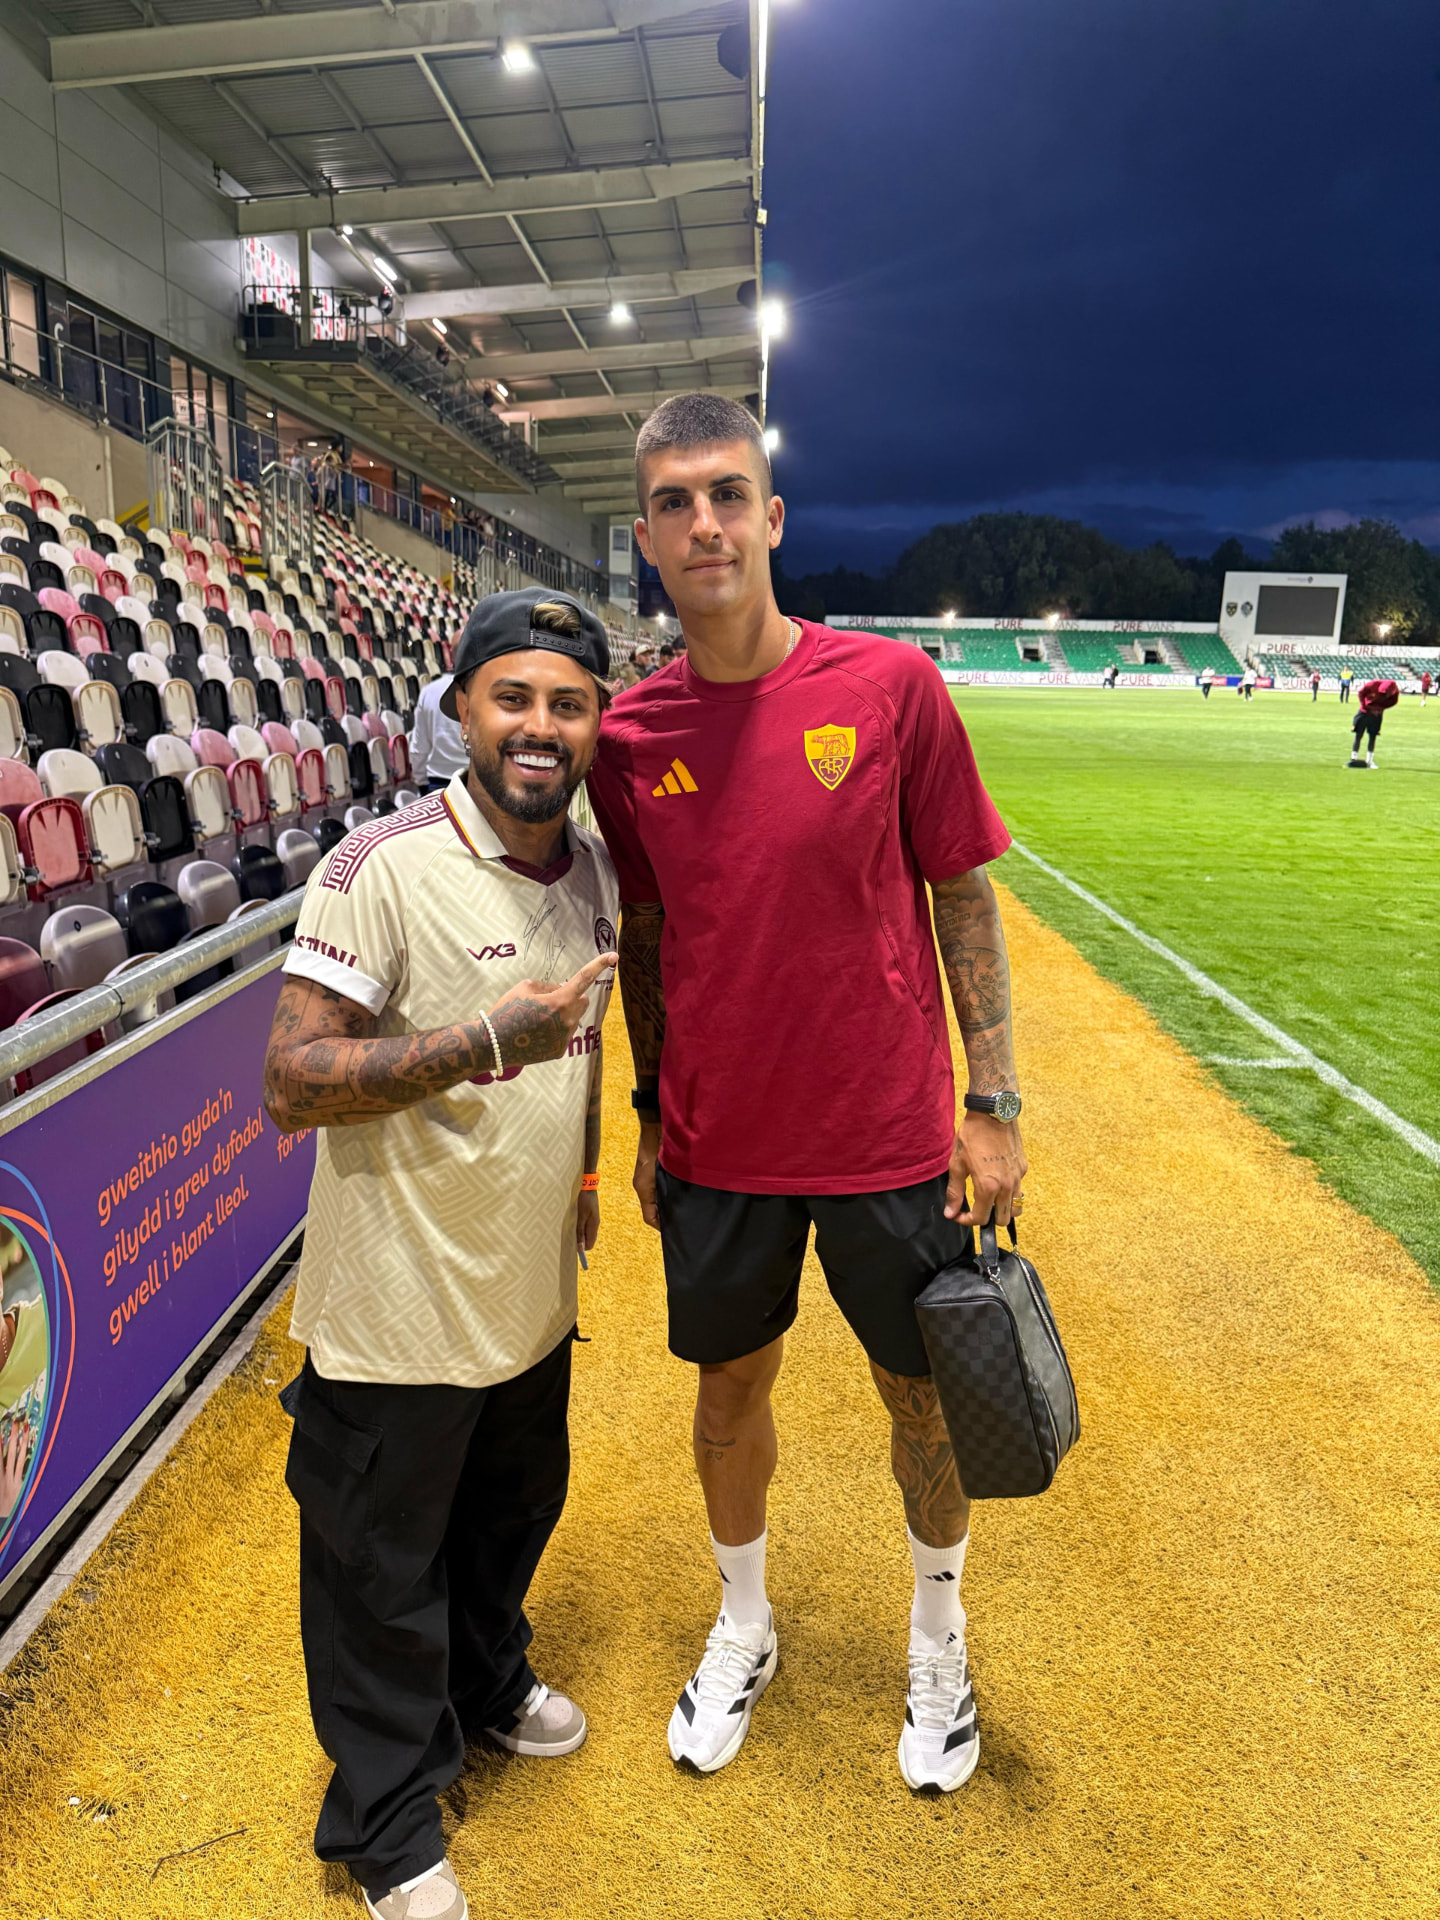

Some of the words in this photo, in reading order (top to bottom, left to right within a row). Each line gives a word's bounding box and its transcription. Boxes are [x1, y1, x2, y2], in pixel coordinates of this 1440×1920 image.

[849, 616, 876, 627] PURE
[885, 617, 913, 628] VANS
[994, 618, 1023, 629] PURE
[1114, 620, 1143, 632] PURE
[1147, 621, 1175, 632] VANS
[1267, 643, 1296, 654] PURE
[1301, 644, 1331, 655] VANS
[1347, 645, 1376, 656] PURE
[958, 671, 989, 683] PURE
[993, 672, 1024, 684] VANS
[1039, 673, 1070, 684] PURE
[1121, 674, 1152, 685] PURE
[1157, 675, 1187, 685] VANS
[466, 943, 517, 961] VX3
[277, 1133, 295, 1163] for
[98, 1133, 178, 1227] gweithio
[181, 1087, 233, 1156] gyda'n
[103, 1197, 162, 1287] gilydd
[164, 1189, 171, 1221] i
[174, 1162, 210, 1220] greu
[212, 1106, 264, 1175] dyfodol
[109, 1259, 162, 1346] gwell
[162, 1250, 169, 1281] i
[171, 1211, 215, 1272] blant
[215, 1173, 249, 1226] lleol.
